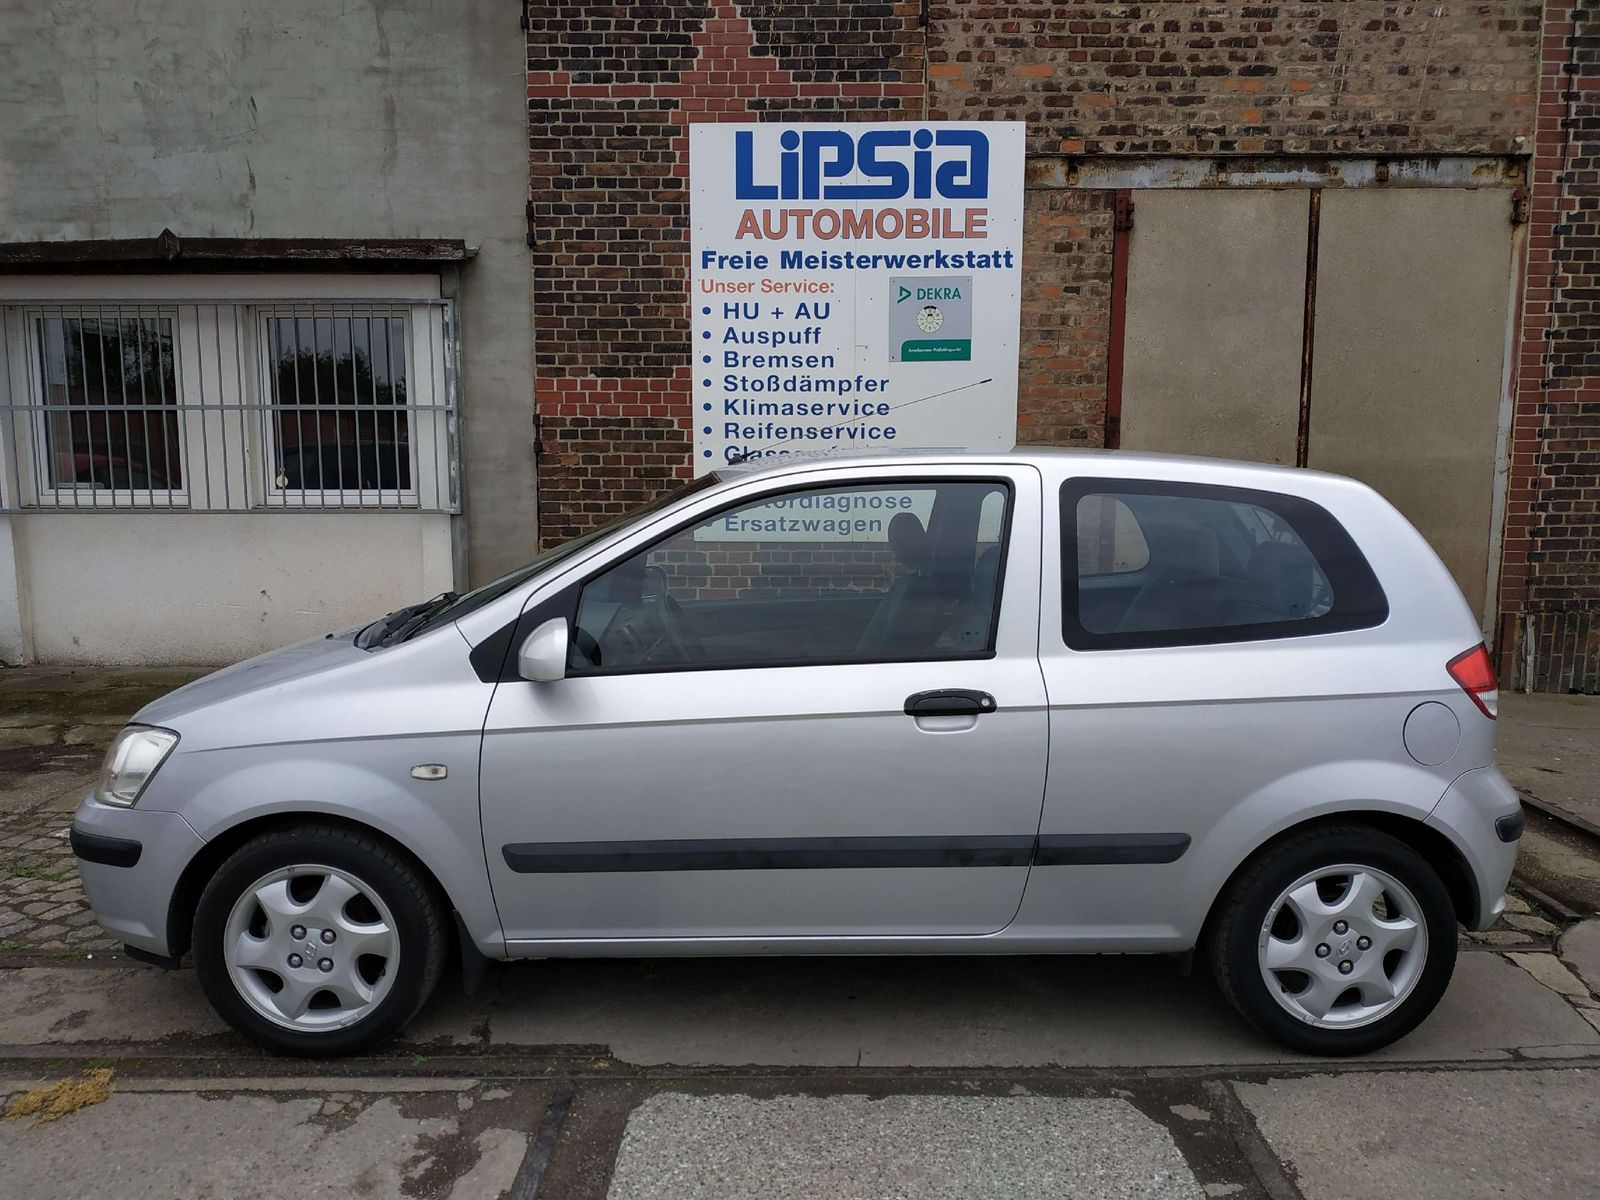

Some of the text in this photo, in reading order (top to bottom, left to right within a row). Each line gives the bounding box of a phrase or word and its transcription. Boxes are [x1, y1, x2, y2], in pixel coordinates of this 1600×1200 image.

[735, 208, 988, 240] AUTOMOBILE
[701, 250, 1014, 270] Freie Meisterwerkstatt
[701, 278, 835, 294] Unser Service:
[917, 288, 962, 300] DEKRA
[723, 302, 759, 320] HU
[794, 302, 830, 320] AU
[722, 326, 822, 347] Auspuff
[724, 351, 834, 368] Bremsen
[723, 375, 890, 395] Stoßdämpfer
[724, 399, 890, 416] Klimaservice
[724, 422, 897, 440] Reifenservice
[724, 515, 882, 536] Ersatzwagen
